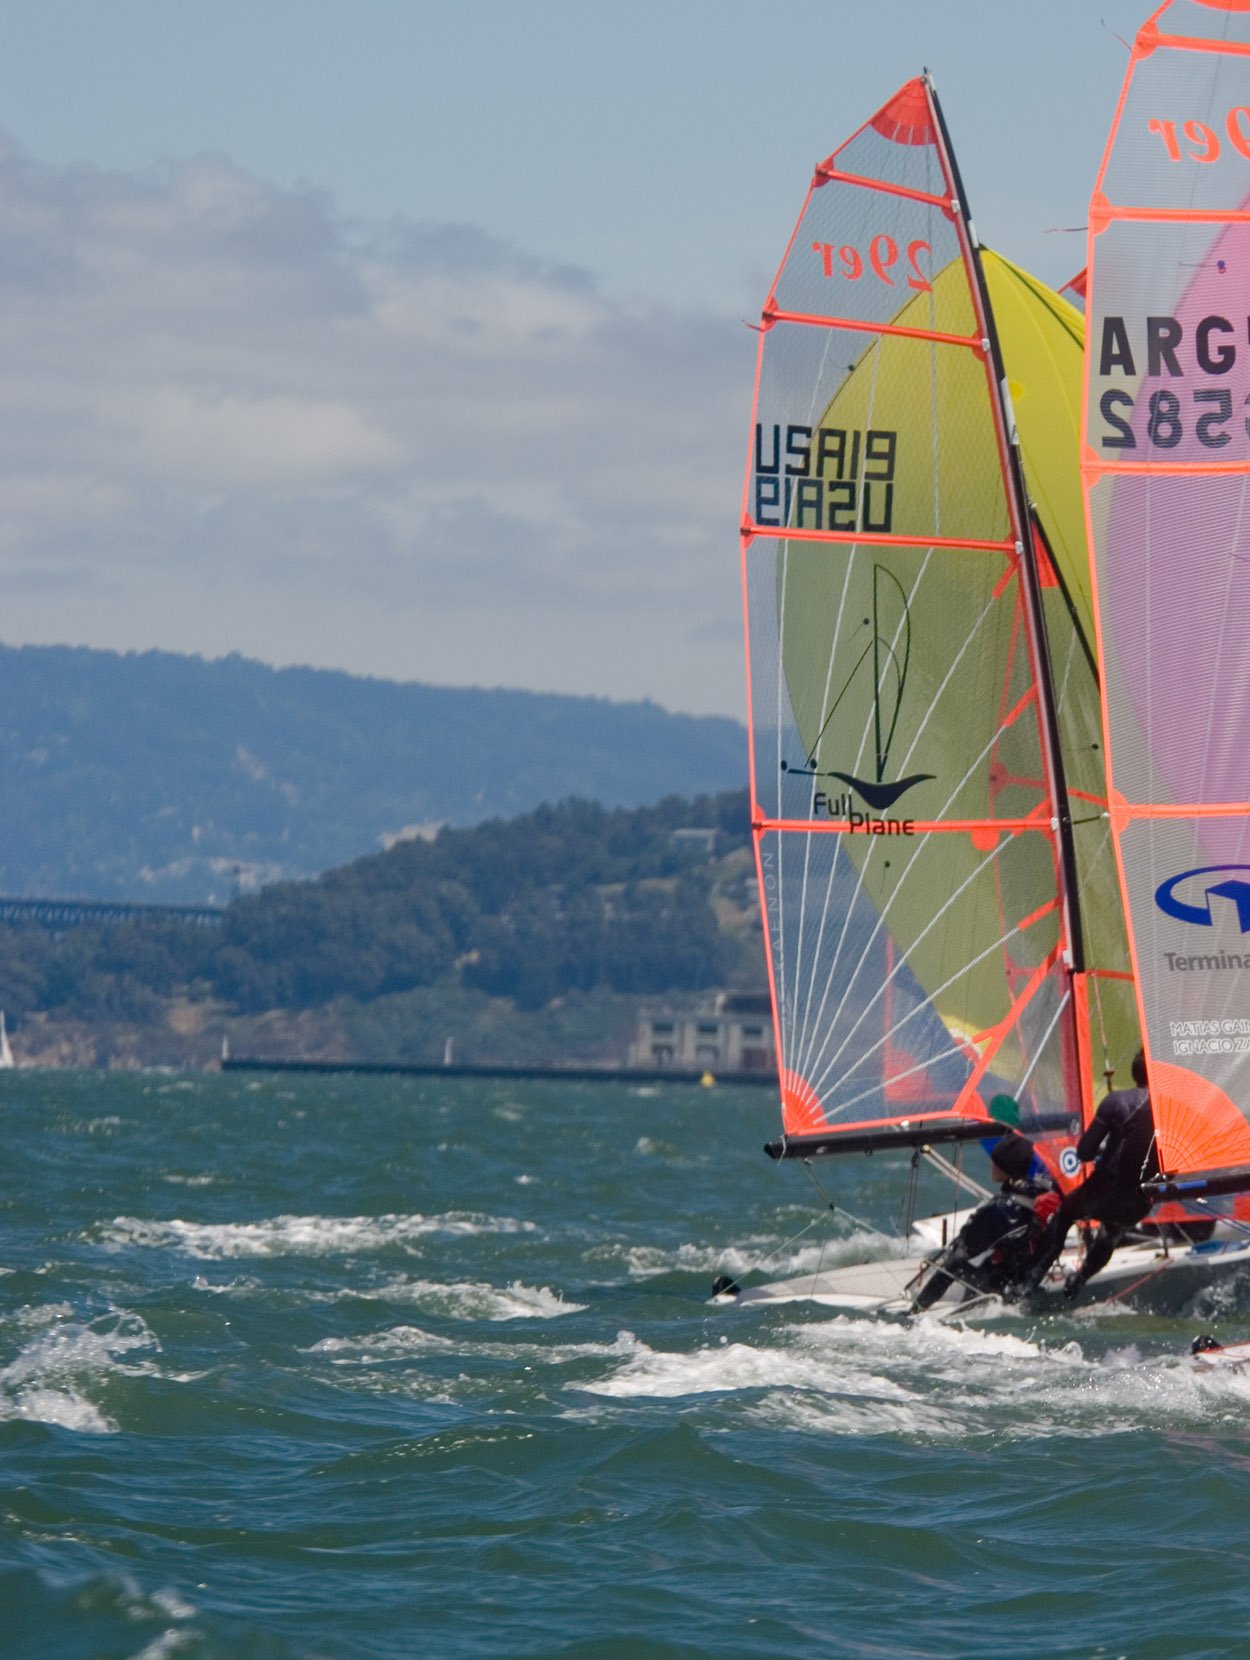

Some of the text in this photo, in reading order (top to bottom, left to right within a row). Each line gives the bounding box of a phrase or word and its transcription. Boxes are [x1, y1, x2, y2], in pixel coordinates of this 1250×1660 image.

[755, 423, 898, 482] USA19
[813, 792, 852, 817] Full
[850, 812, 915, 836] Plane
[1169, 1019, 1220, 1036] MATIAS
[1173, 1038, 1234, 1055] IGNACIO
